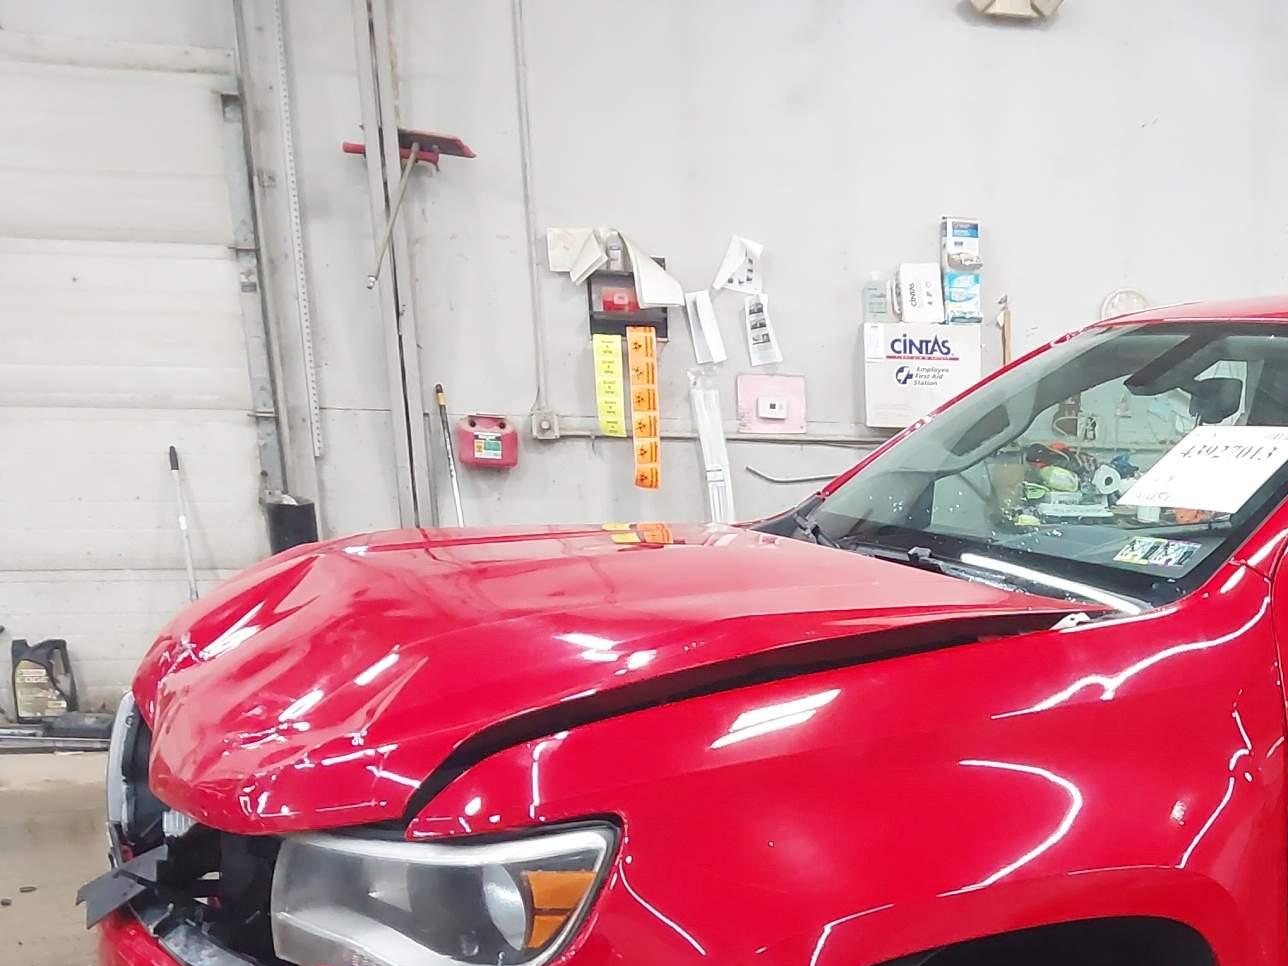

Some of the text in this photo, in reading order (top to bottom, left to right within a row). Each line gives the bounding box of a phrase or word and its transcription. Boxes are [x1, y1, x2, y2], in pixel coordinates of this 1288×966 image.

[890, 333, 951, 355] CINTAS
[916, 366, 949, 374] Employee
[1180, 444, 1279, 461] 43927013
